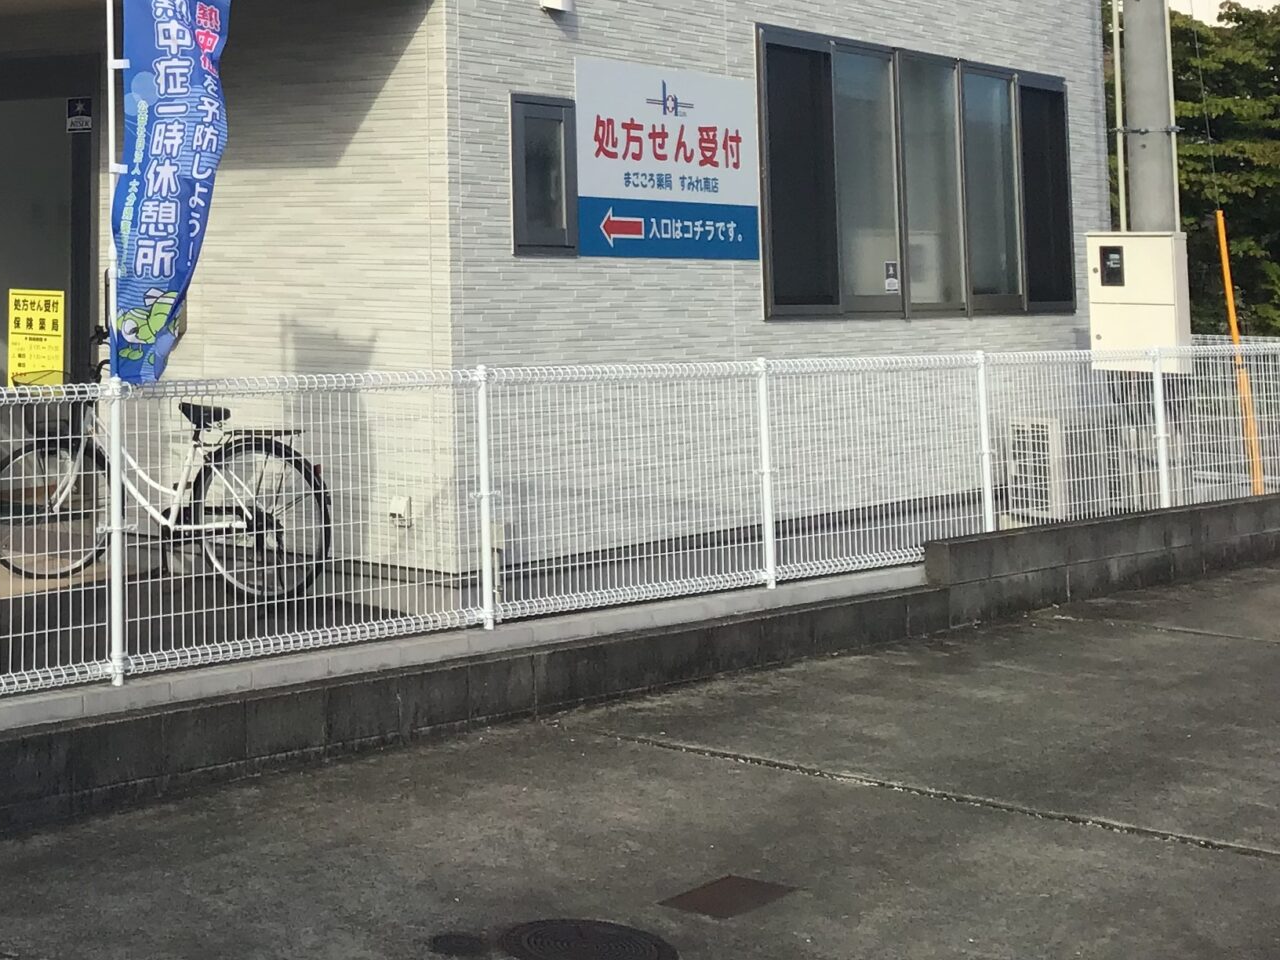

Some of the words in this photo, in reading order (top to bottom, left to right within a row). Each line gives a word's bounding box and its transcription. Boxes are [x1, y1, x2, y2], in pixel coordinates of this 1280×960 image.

[593, 114, 742, 170] 処方せん受付
[623, 172, 673, 191] まごころ薬局
[649, 218, 744, 243] 入口はコチラです。
[14, 298, 59, 313] 処方せん受付
